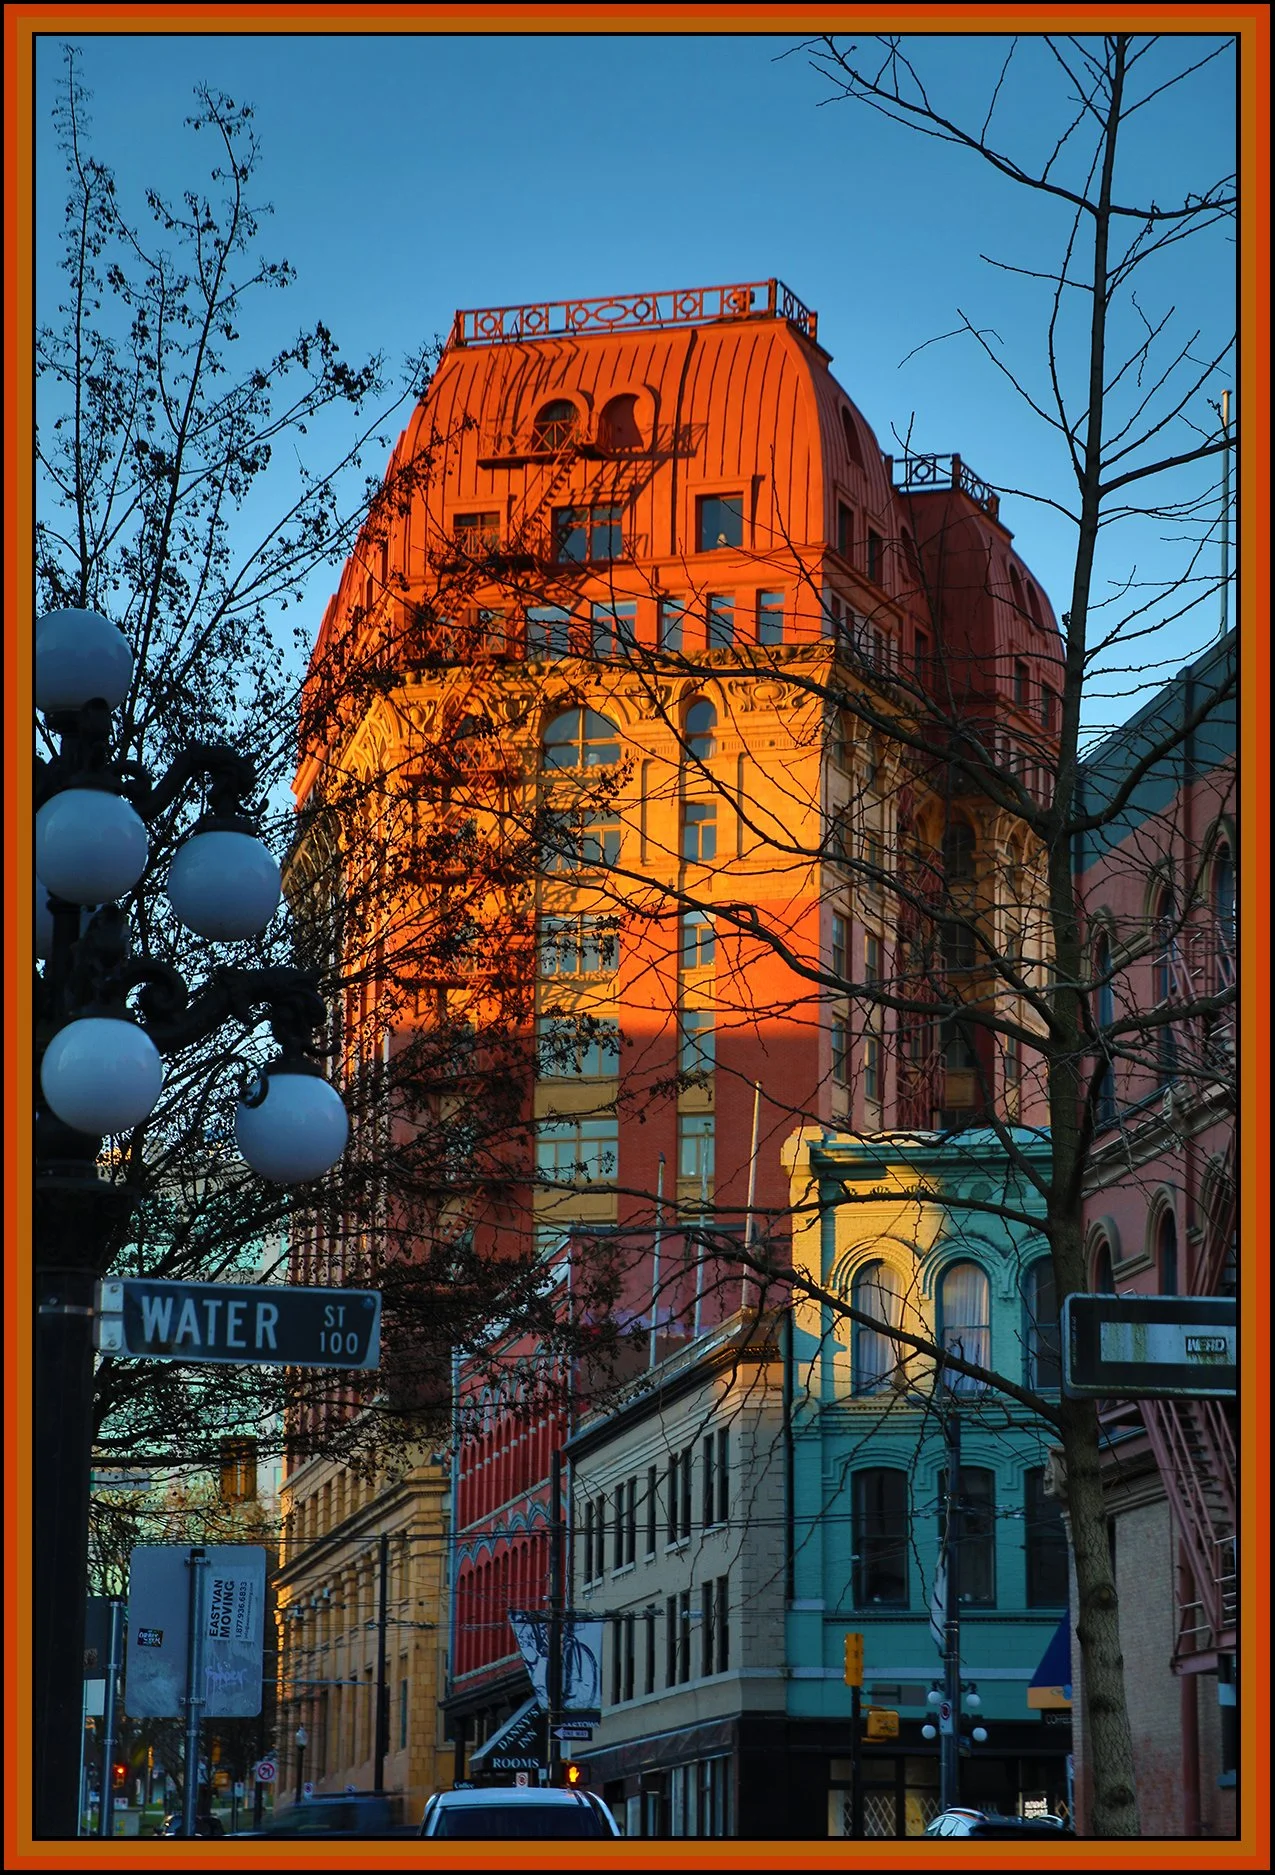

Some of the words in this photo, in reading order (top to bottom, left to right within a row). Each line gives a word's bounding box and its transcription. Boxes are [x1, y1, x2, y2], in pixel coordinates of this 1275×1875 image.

[141, 1295, 279, 1350] WATER
[324, 1305, 346, 1327] ST
[319, 1332, 359, 1355] 100
[209, 1579, 223, 1638] EASTVAN
[219, 1580, 235, 1639] MOVING
[497, 1707, 540, 1751] DANNY'S
[517, 1727, 538, 1749] INN
[492, 1757, 540, 1769] ROOMS
